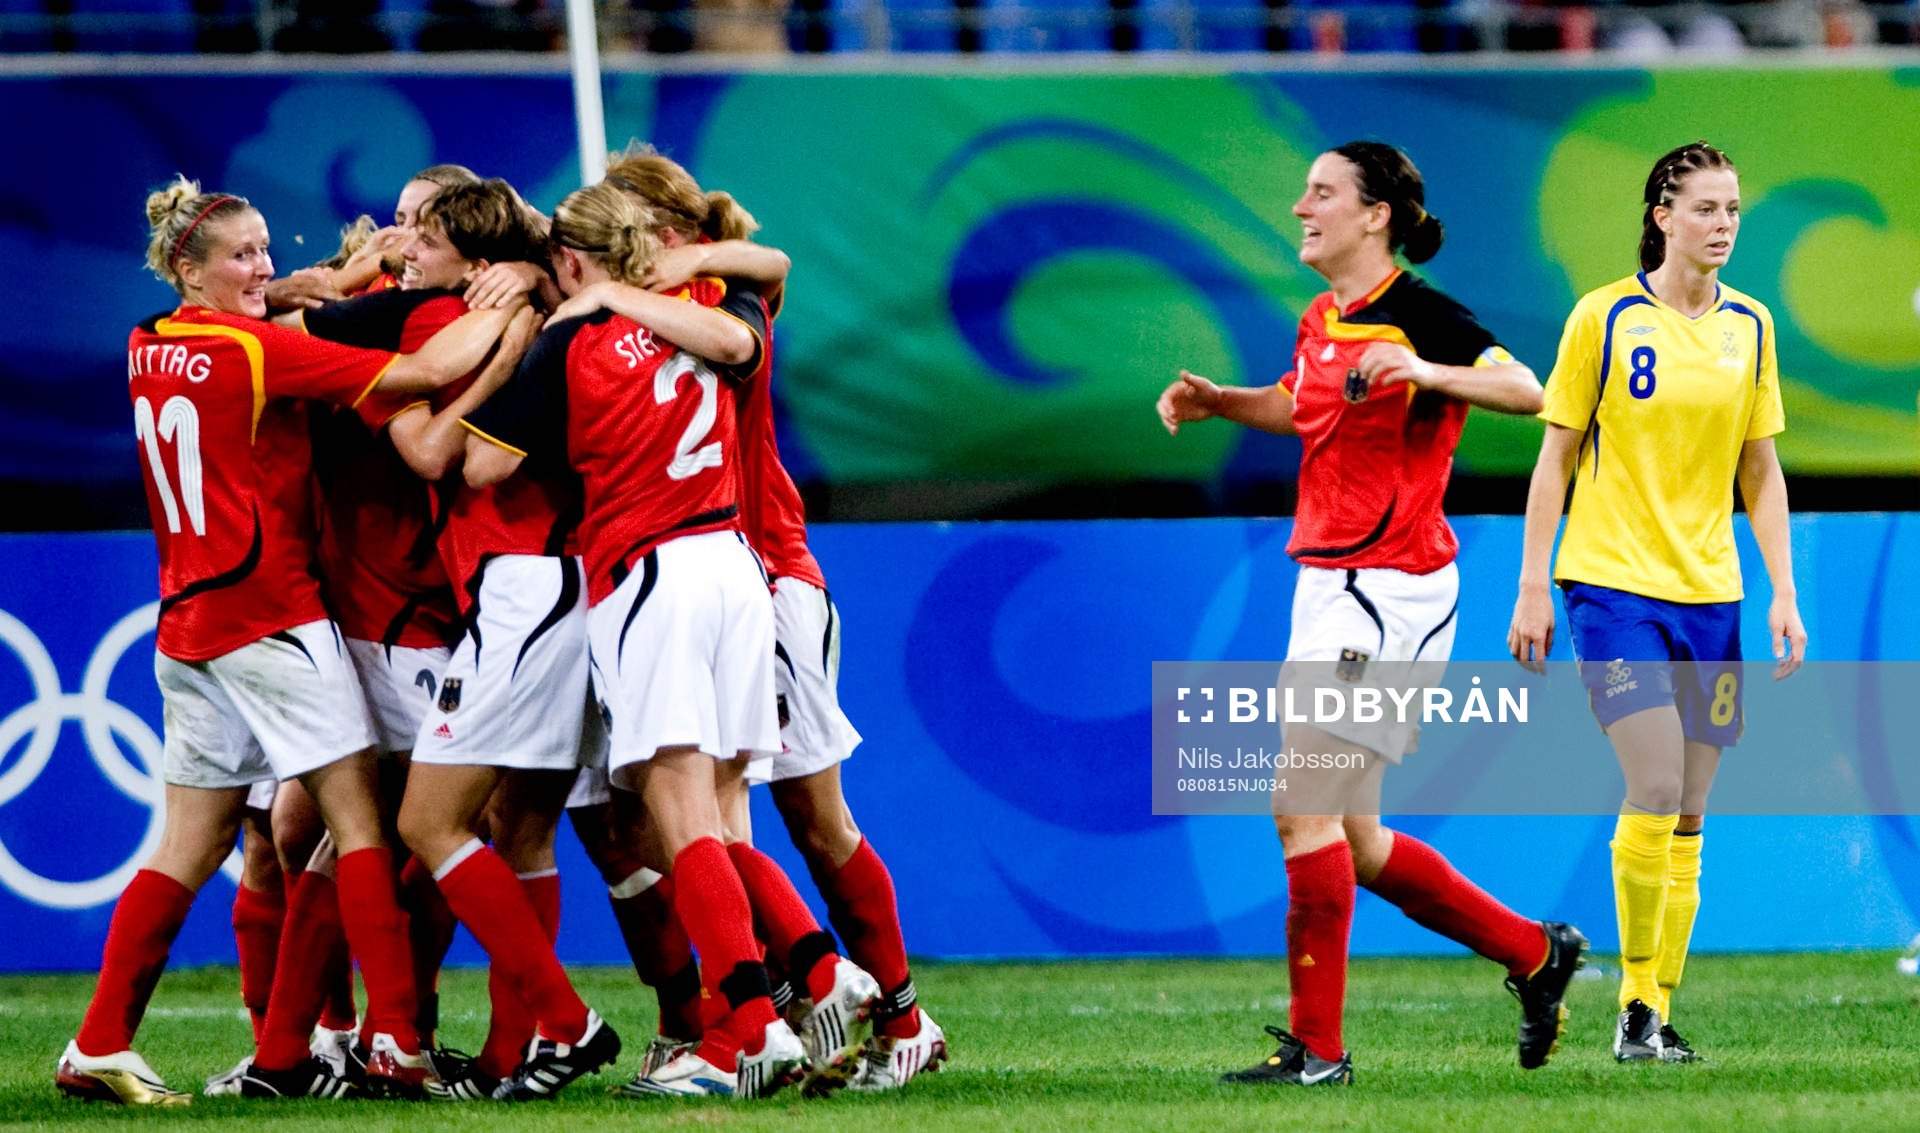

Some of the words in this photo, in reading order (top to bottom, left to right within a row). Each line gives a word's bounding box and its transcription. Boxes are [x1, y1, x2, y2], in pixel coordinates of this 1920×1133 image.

[1629, 346, 1656, 400] 8
[653, 351, 723, 481] 2
[134, 395, 206, 536] 11
[1606, 680, 1638, 698] SWE
[1710, 672, 1737, 727] 8
